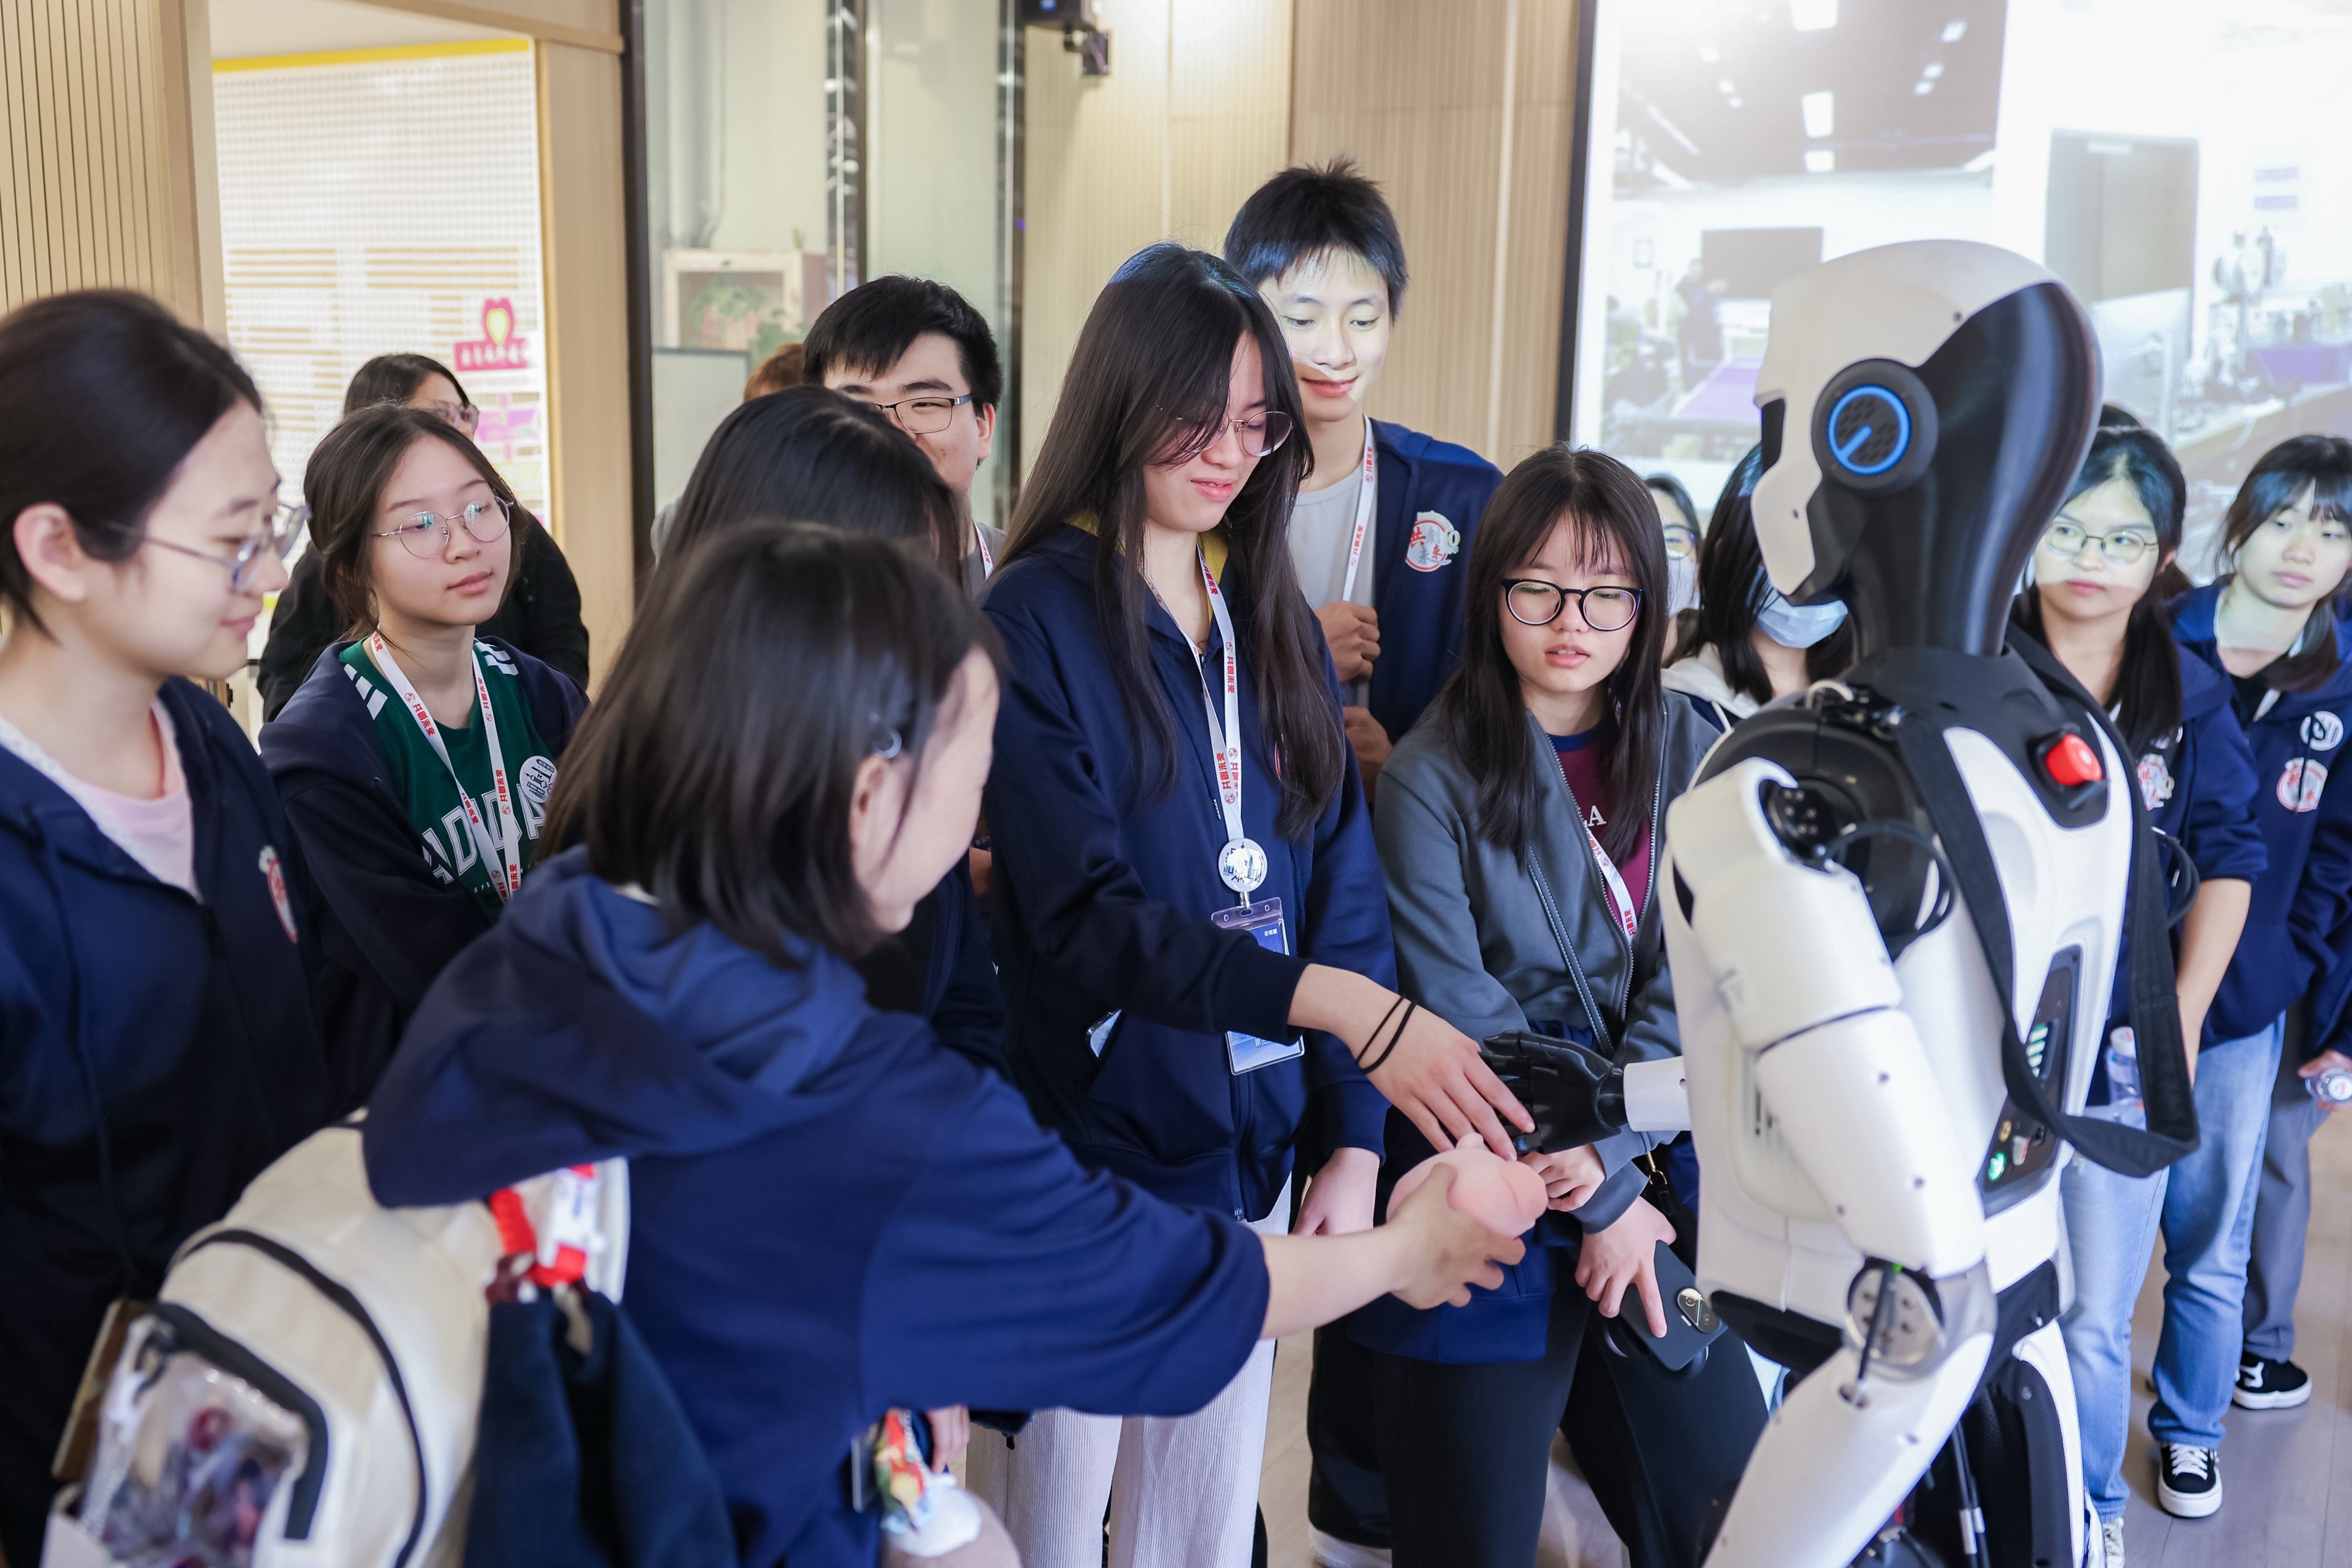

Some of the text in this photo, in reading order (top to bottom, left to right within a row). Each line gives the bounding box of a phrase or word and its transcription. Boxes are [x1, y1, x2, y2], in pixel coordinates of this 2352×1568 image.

[1227, 656, 1235, 693] 共創未來
[412, 703, 436, 736] 共創未來
[496, 769, 509, 802] 共創未來
[1216, 752, 1231, 790] 共創未來
[461, 792, 479, 825] 共創未來
